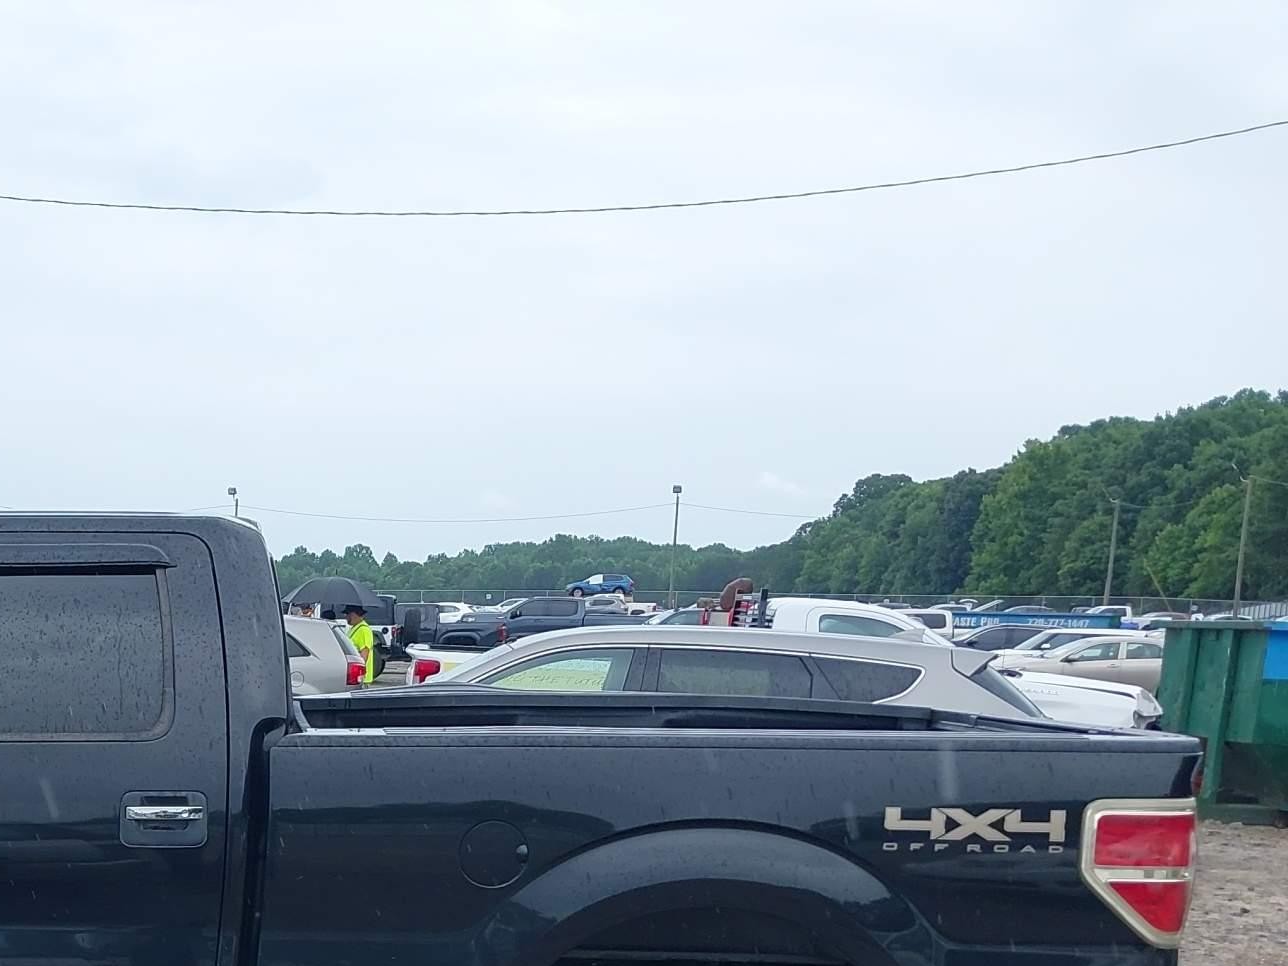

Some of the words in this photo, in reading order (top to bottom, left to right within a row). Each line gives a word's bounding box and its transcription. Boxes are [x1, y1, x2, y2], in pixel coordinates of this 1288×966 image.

[952, 617, 977, 626] ASTE
[884, 806, 1067, 842] 4X4
[882, 842, 949, 852] OFF
[966, 844, 1064, 853] ROAD
